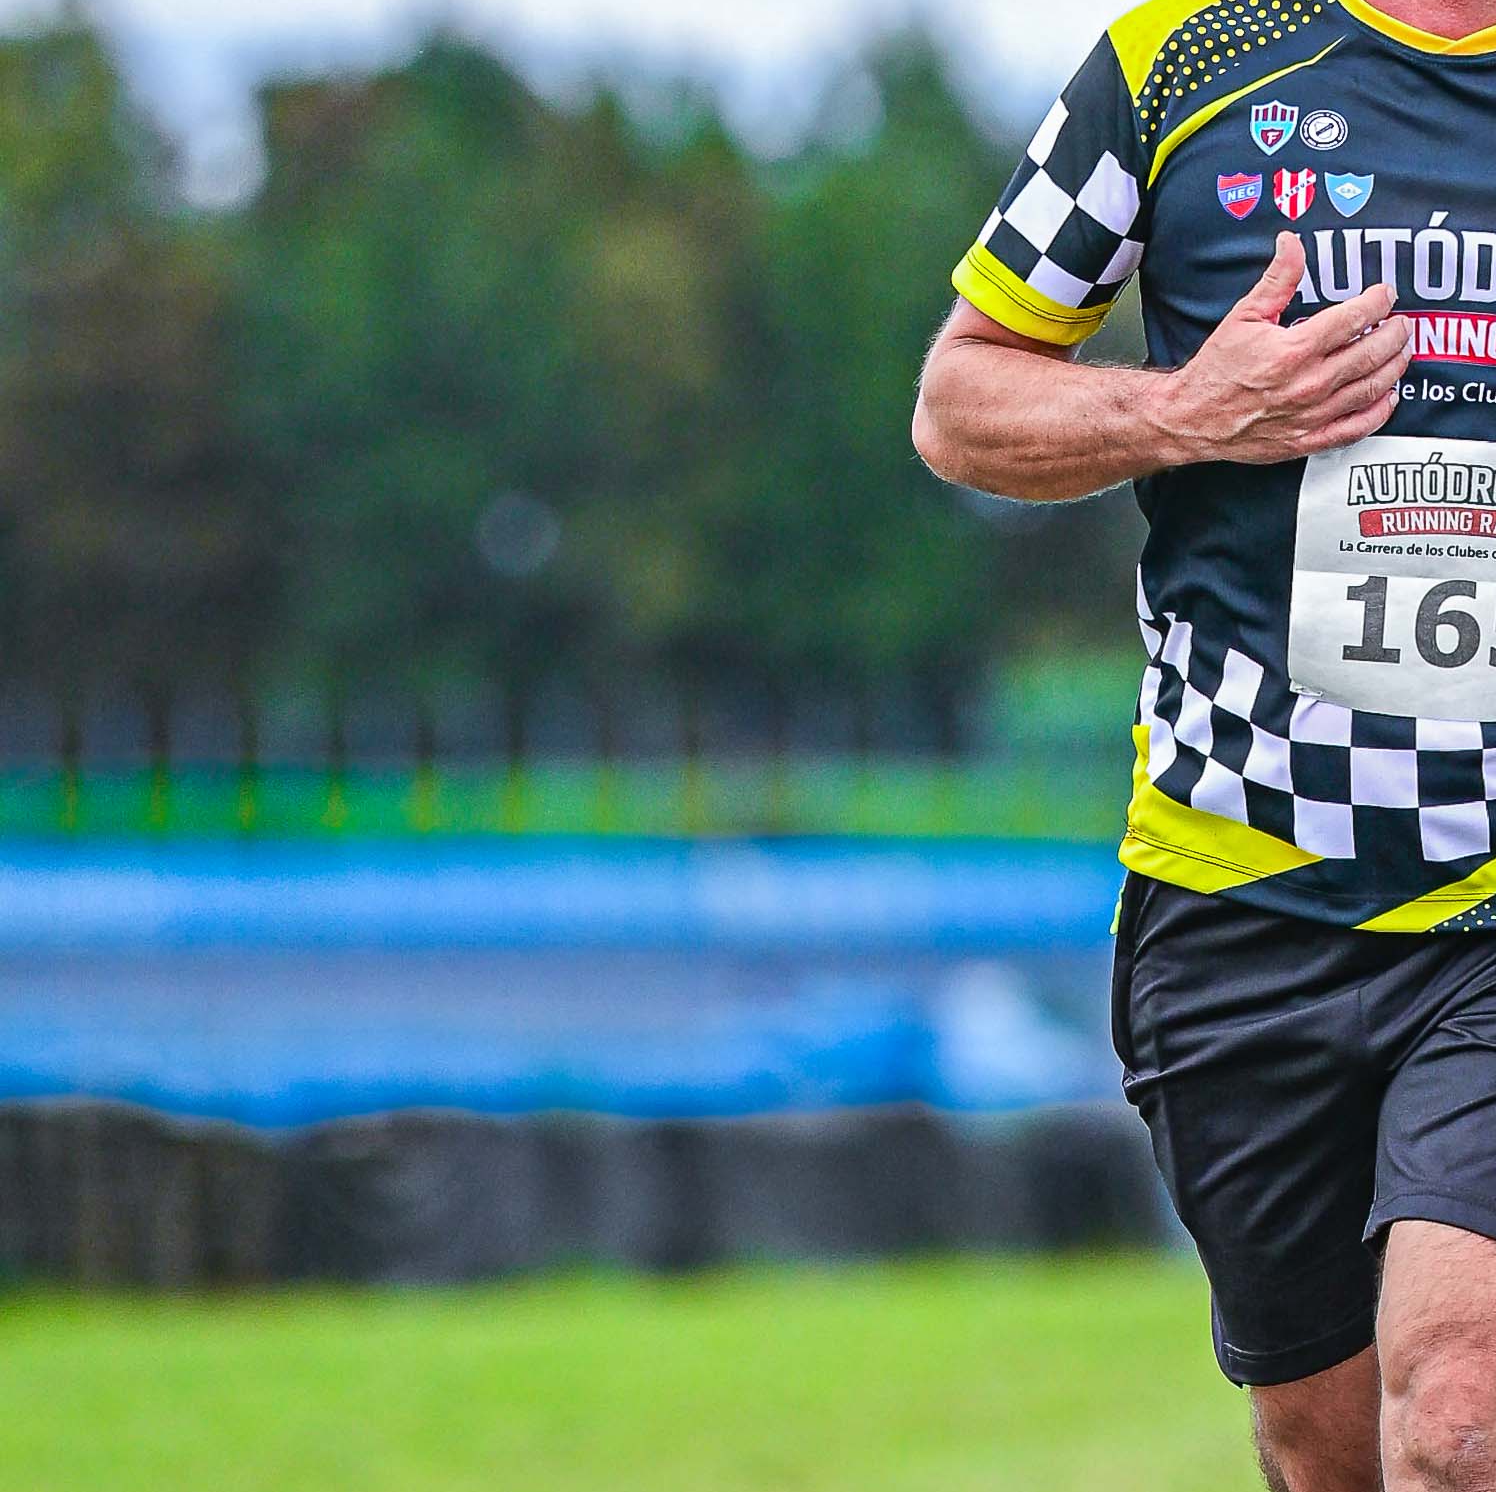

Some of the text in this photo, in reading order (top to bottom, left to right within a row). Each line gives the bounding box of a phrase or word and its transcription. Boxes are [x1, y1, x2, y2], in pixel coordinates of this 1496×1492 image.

[1227, 186, 1256, 202] NEC
[1421, 379, 1455, 402] los
[1380, 510, 1473, 534] RUNNING
[1339, 540, 1354, 552] La
[1356, 541, 1404, 555] Carrera
[1406, 543, 1423, 556] de
[1425, 544, 1444, 557] los
[1446, 545, 1489, 559] Clubes
